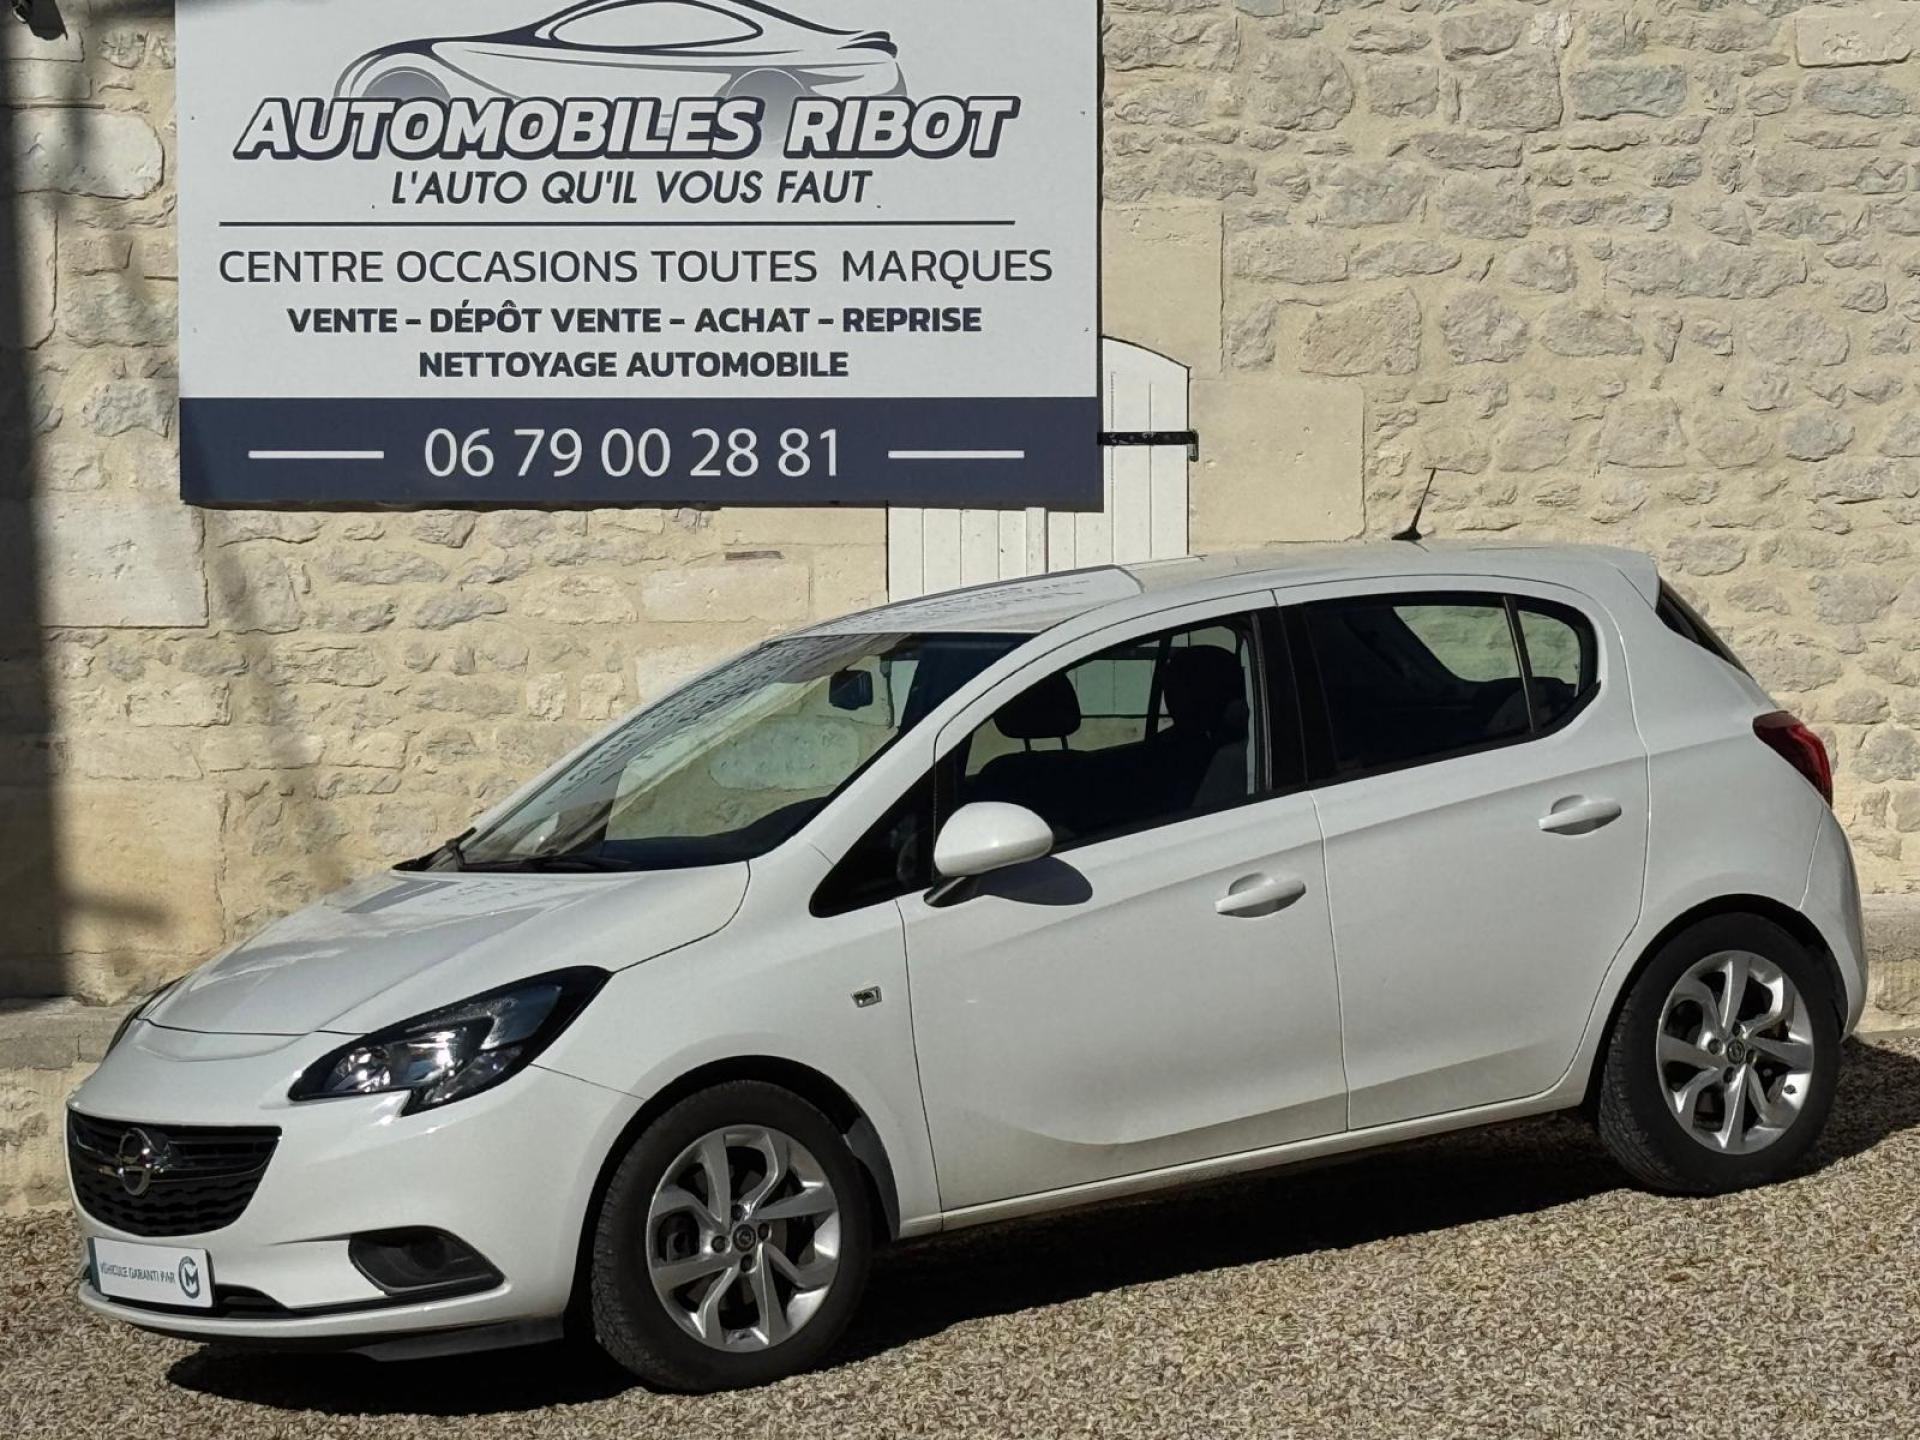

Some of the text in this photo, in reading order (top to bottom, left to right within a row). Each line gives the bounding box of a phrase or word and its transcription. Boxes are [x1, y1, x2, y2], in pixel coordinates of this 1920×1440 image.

[234, 95, 1021, 159] AUTOMOBILES RIBOT
[391, 170, 874, 204] L'AUTO QU'IL VOUS FAUT
[219, 249, 1053, 290] CENTRE OCCASIONS TOUTES MARQUES
[287, 308, 398, 333] VENTE
[430, 299, 543, 334] DÉPÔT
[550, 307, 662, 333] VENTE
[694, 307, 811, 333] ACHAT
[842, 306, 982, 333] REPRISE
[419, 351, 849, 378] NETTOYAGE AUTOMOBILE
[424, 427, 837, 477] 06 79 00 28 81
